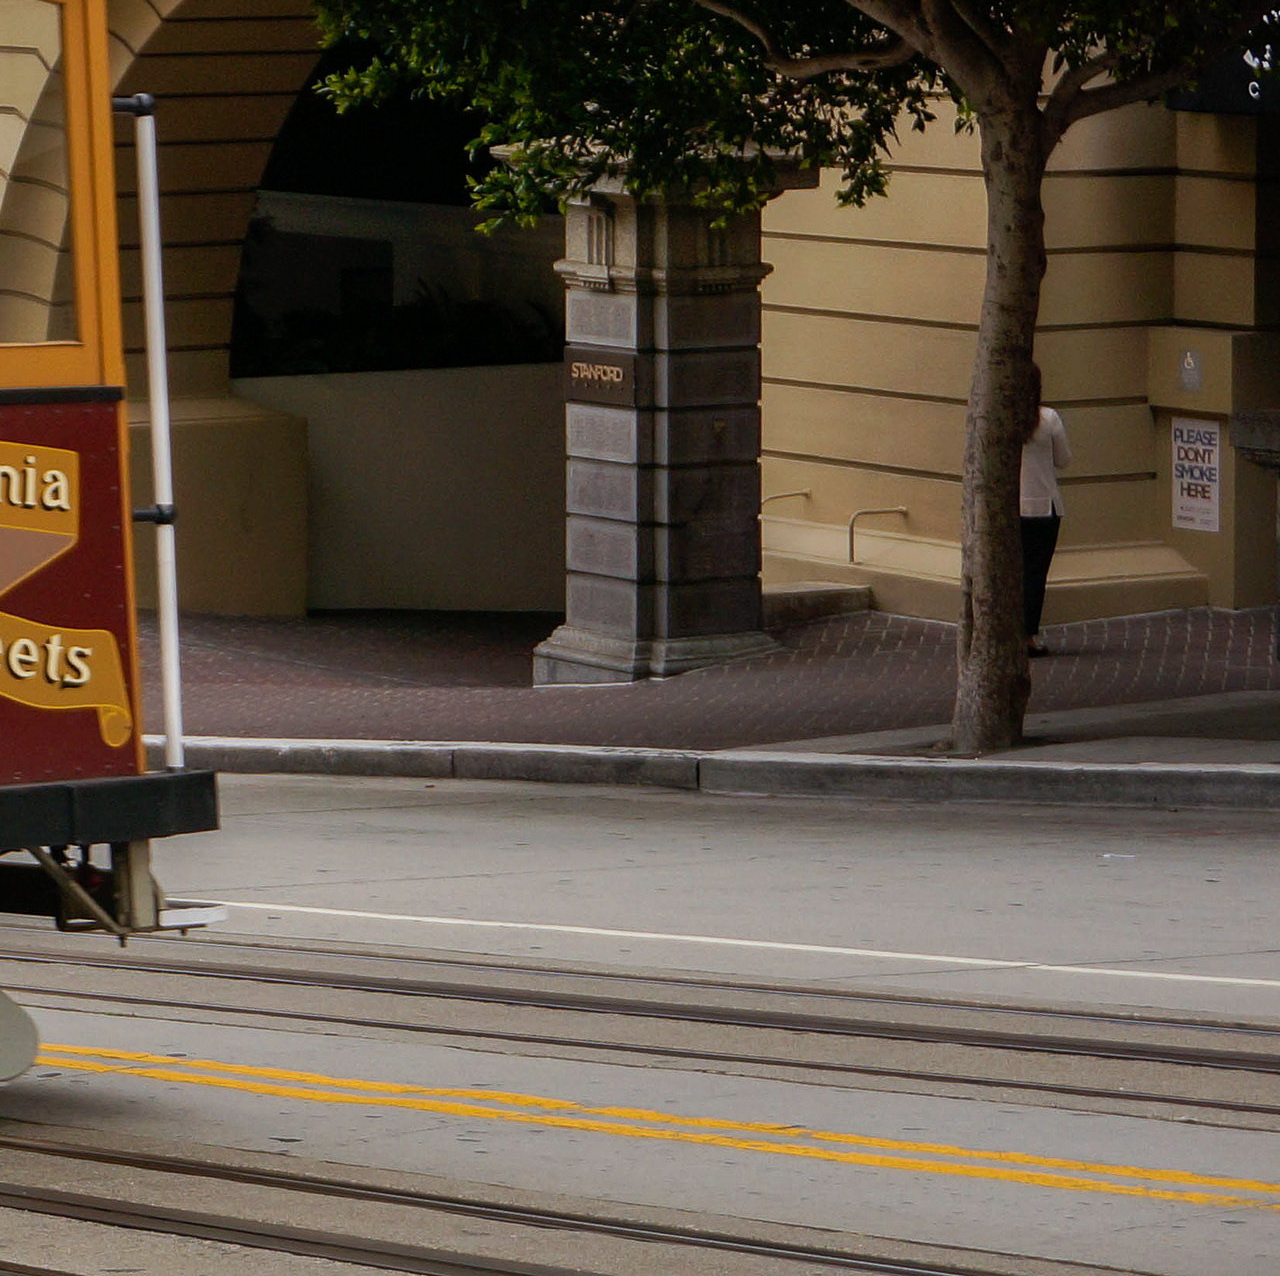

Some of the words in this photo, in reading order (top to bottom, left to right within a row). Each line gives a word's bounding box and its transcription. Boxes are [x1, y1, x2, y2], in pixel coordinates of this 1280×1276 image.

[571, 362, 623, 382] STANFORD
[1174, 427, 1217, 447] PLEASE
[1174, 464, 1217, 483] SMOKE
[1180, 481, 1212, 500] HERE
